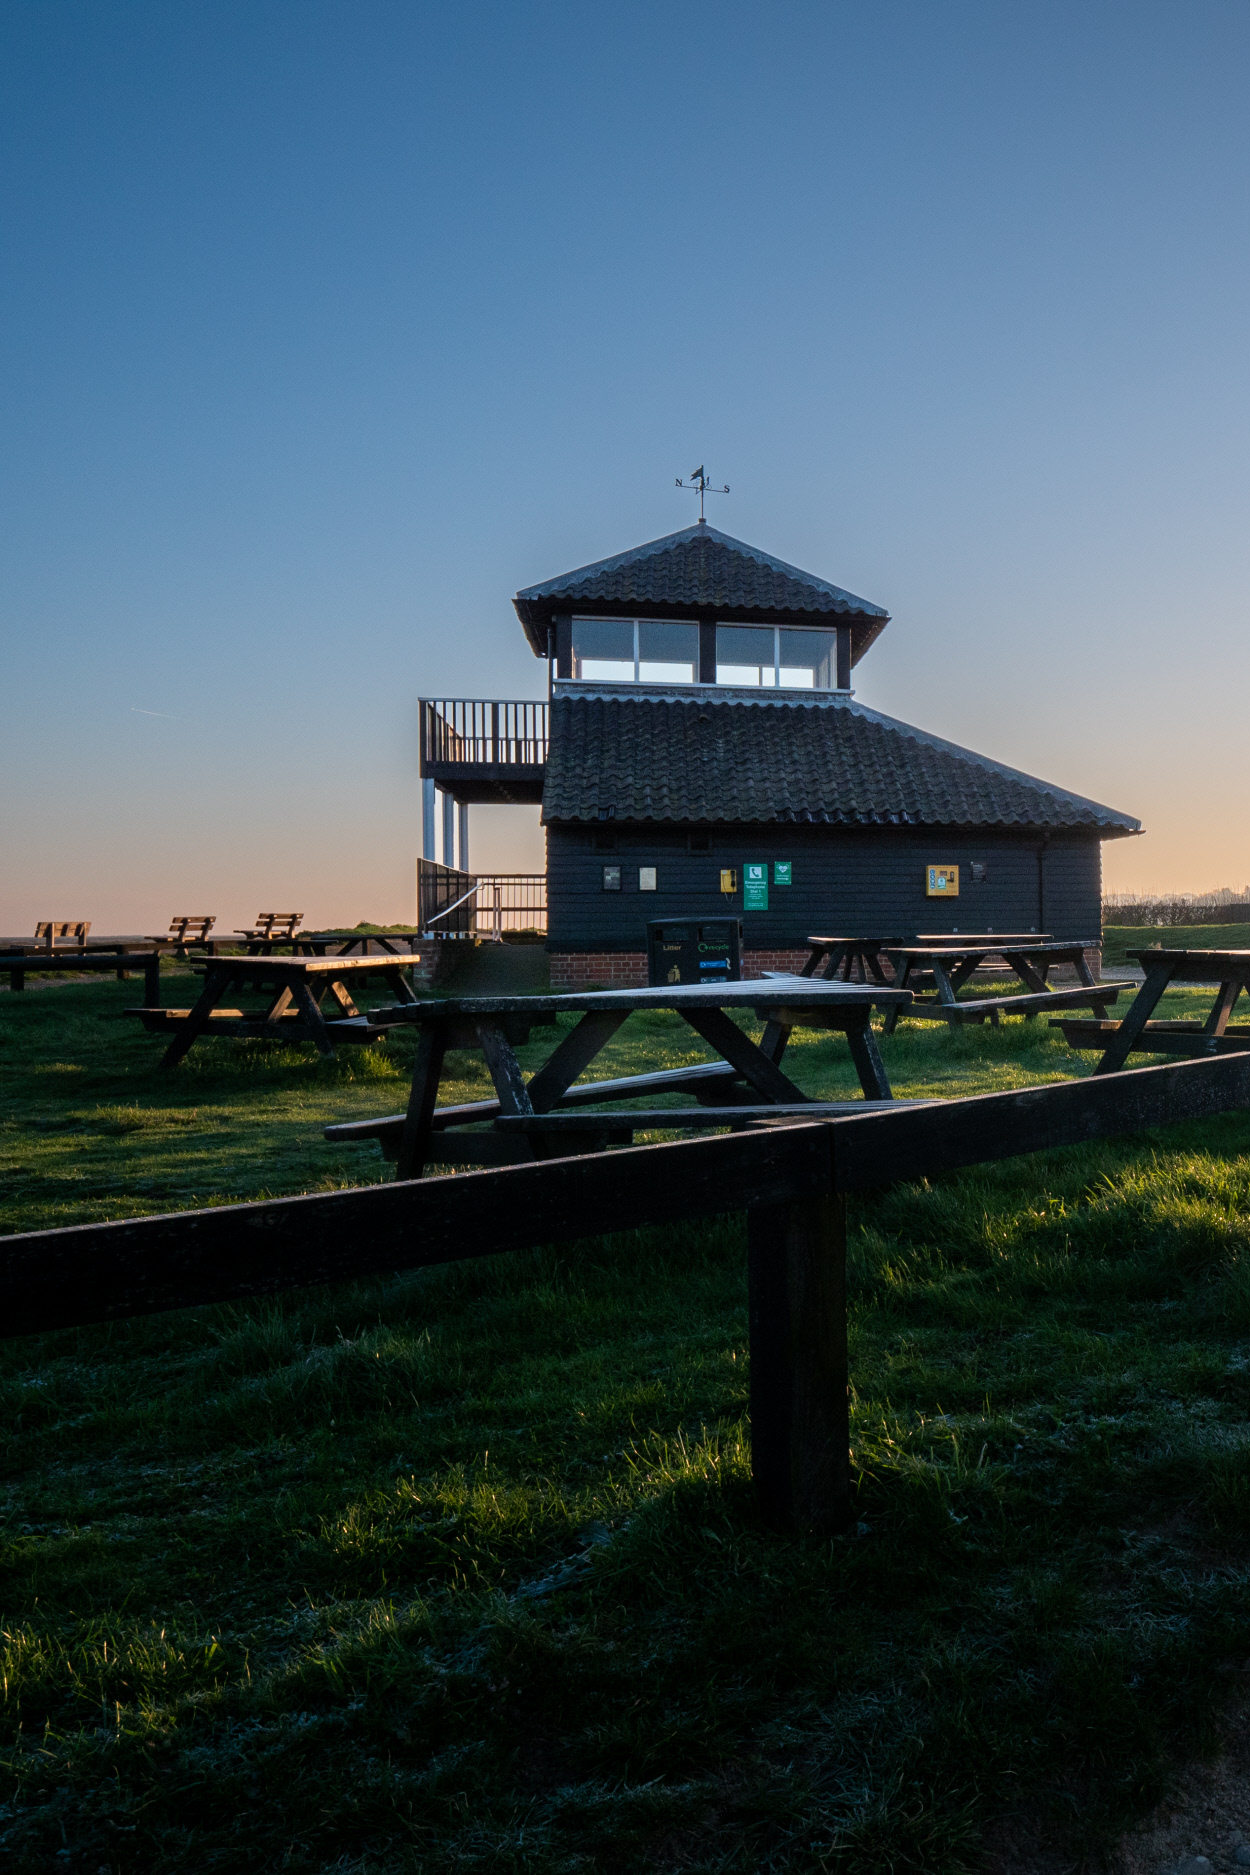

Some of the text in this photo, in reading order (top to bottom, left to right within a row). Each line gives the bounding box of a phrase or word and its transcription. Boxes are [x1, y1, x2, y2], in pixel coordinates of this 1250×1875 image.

[675, 478, 683, 486] N
[724, 485, 730, 493] S
[709, 943, 730, 951] recycle
